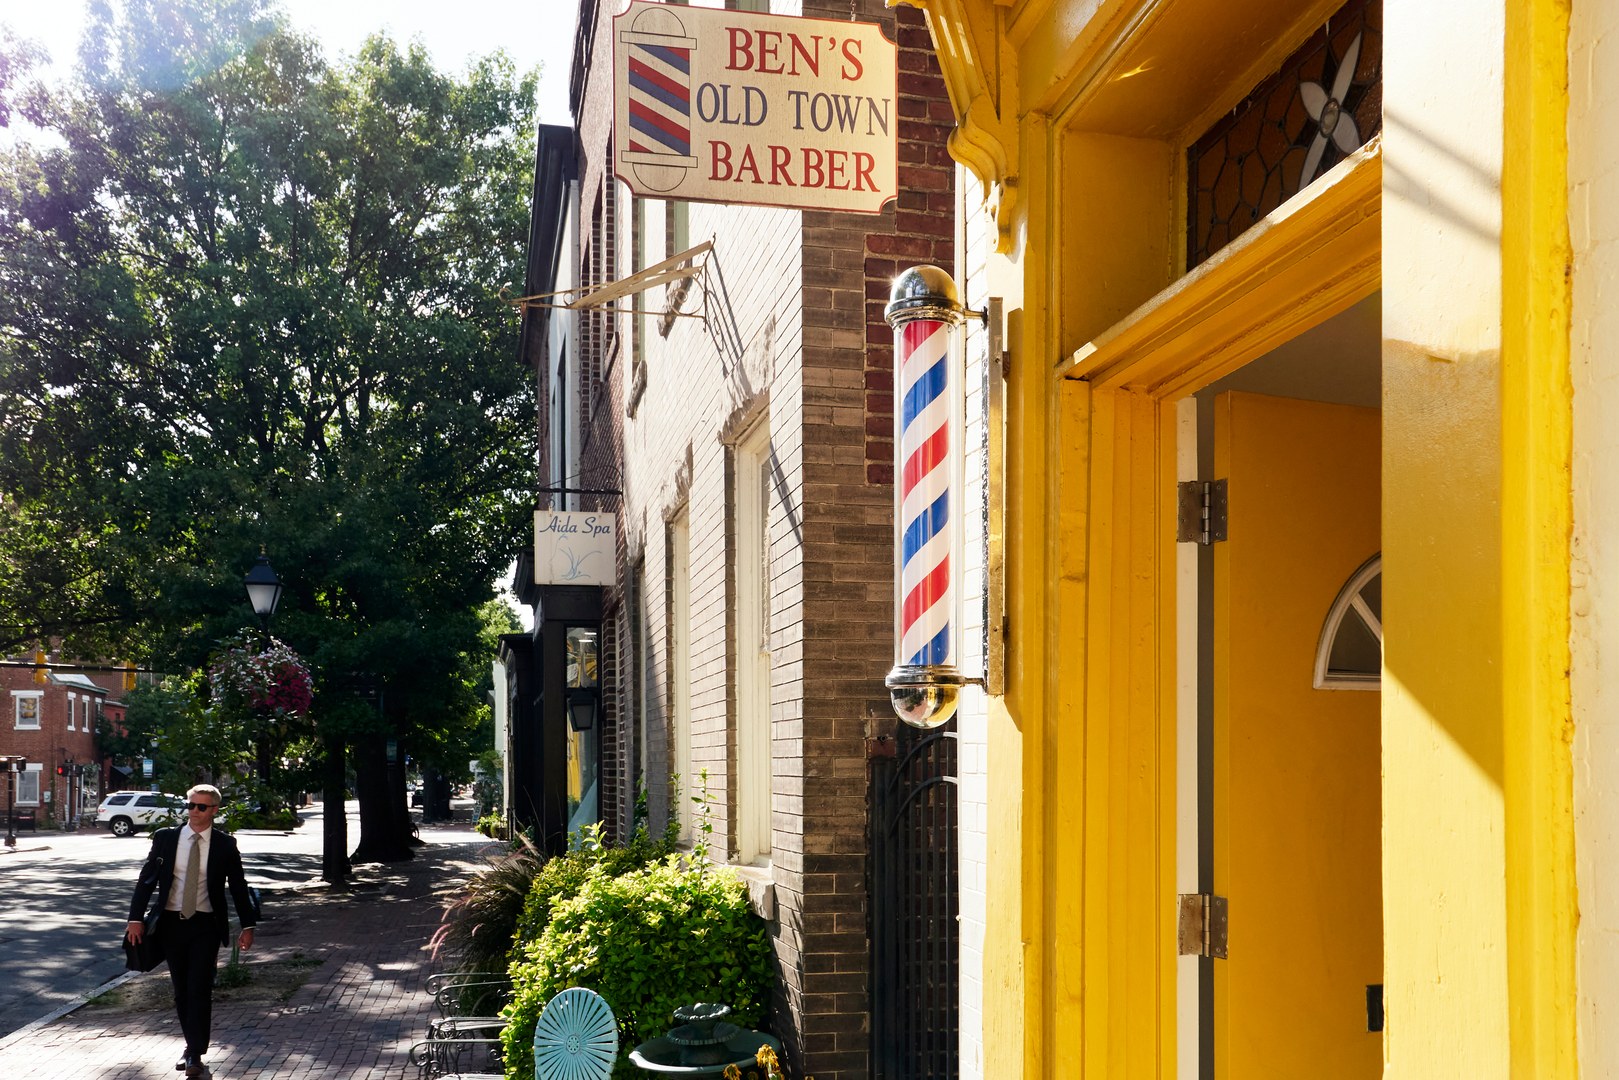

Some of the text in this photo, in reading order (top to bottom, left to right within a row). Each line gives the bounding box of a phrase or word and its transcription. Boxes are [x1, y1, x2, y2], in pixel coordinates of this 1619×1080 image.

[724, 27, 864, 81] BEN'S
[696, 82, 891, 137] OLD TOWN
[707, 140, 881, 193] BARBER
[540, 516, 610, 538] Aida Spa
